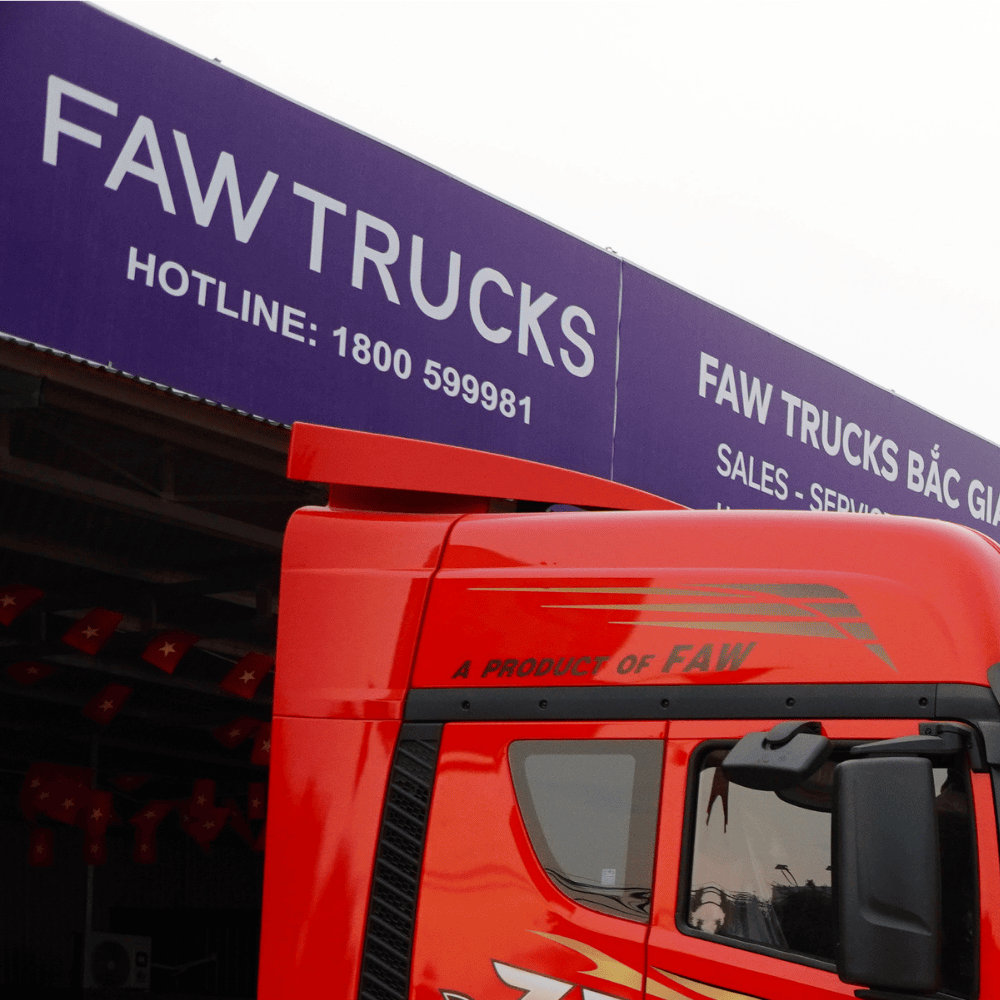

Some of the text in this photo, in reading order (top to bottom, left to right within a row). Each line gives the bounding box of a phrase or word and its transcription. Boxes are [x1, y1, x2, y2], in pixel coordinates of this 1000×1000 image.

[42, 74, 596, 378] FAW TRUCKS
[126, 246, 532, 425] HOTLINE: 1800 599981
[698, 351, 773, 425] FAW
[781, 390, 899, 482] TRUCKS
[907, 443, 961, 509] BẮC
[716, 443, 789, 501] SALES
[452, 643, 756, 678] A PRODUCT OF FAW
